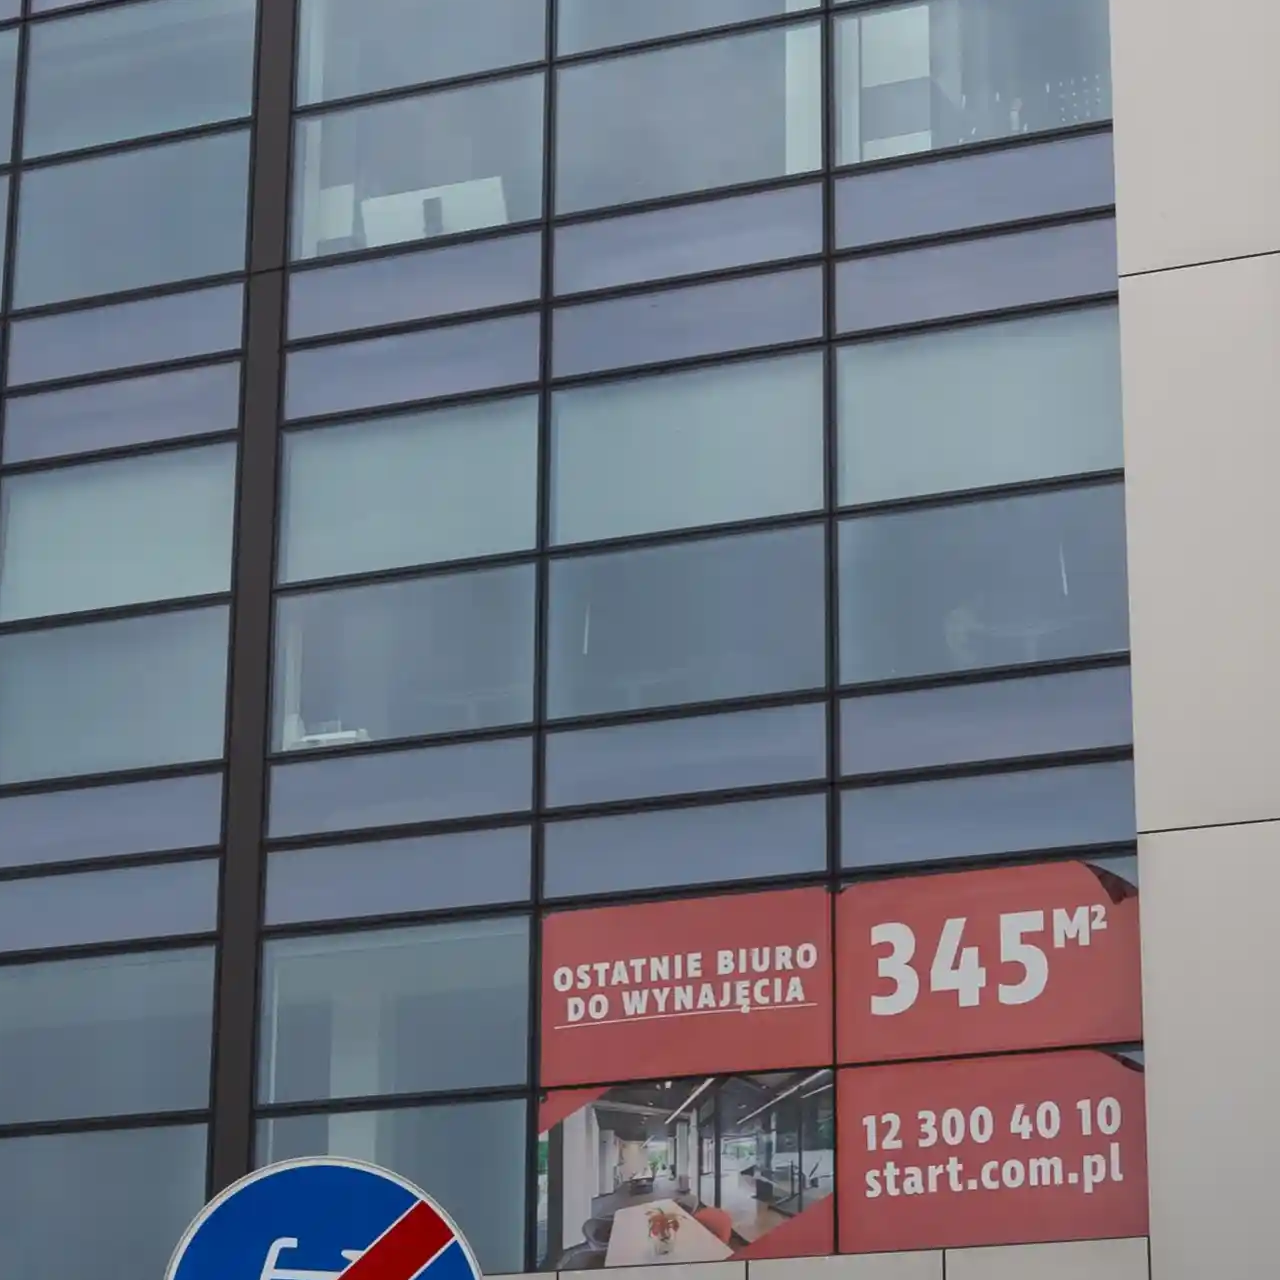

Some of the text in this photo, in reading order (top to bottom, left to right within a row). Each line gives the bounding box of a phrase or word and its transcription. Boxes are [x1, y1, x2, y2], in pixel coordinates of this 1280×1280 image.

[553, 943, 818, 992] OSTATNIE BIURO
[567, 977, 805, 1022] DO WYNAJĘCIA
[863, 1097, 1120, 1151] 12 300 40 10
[865, 1142, 1123, 1198] start.com.pl
